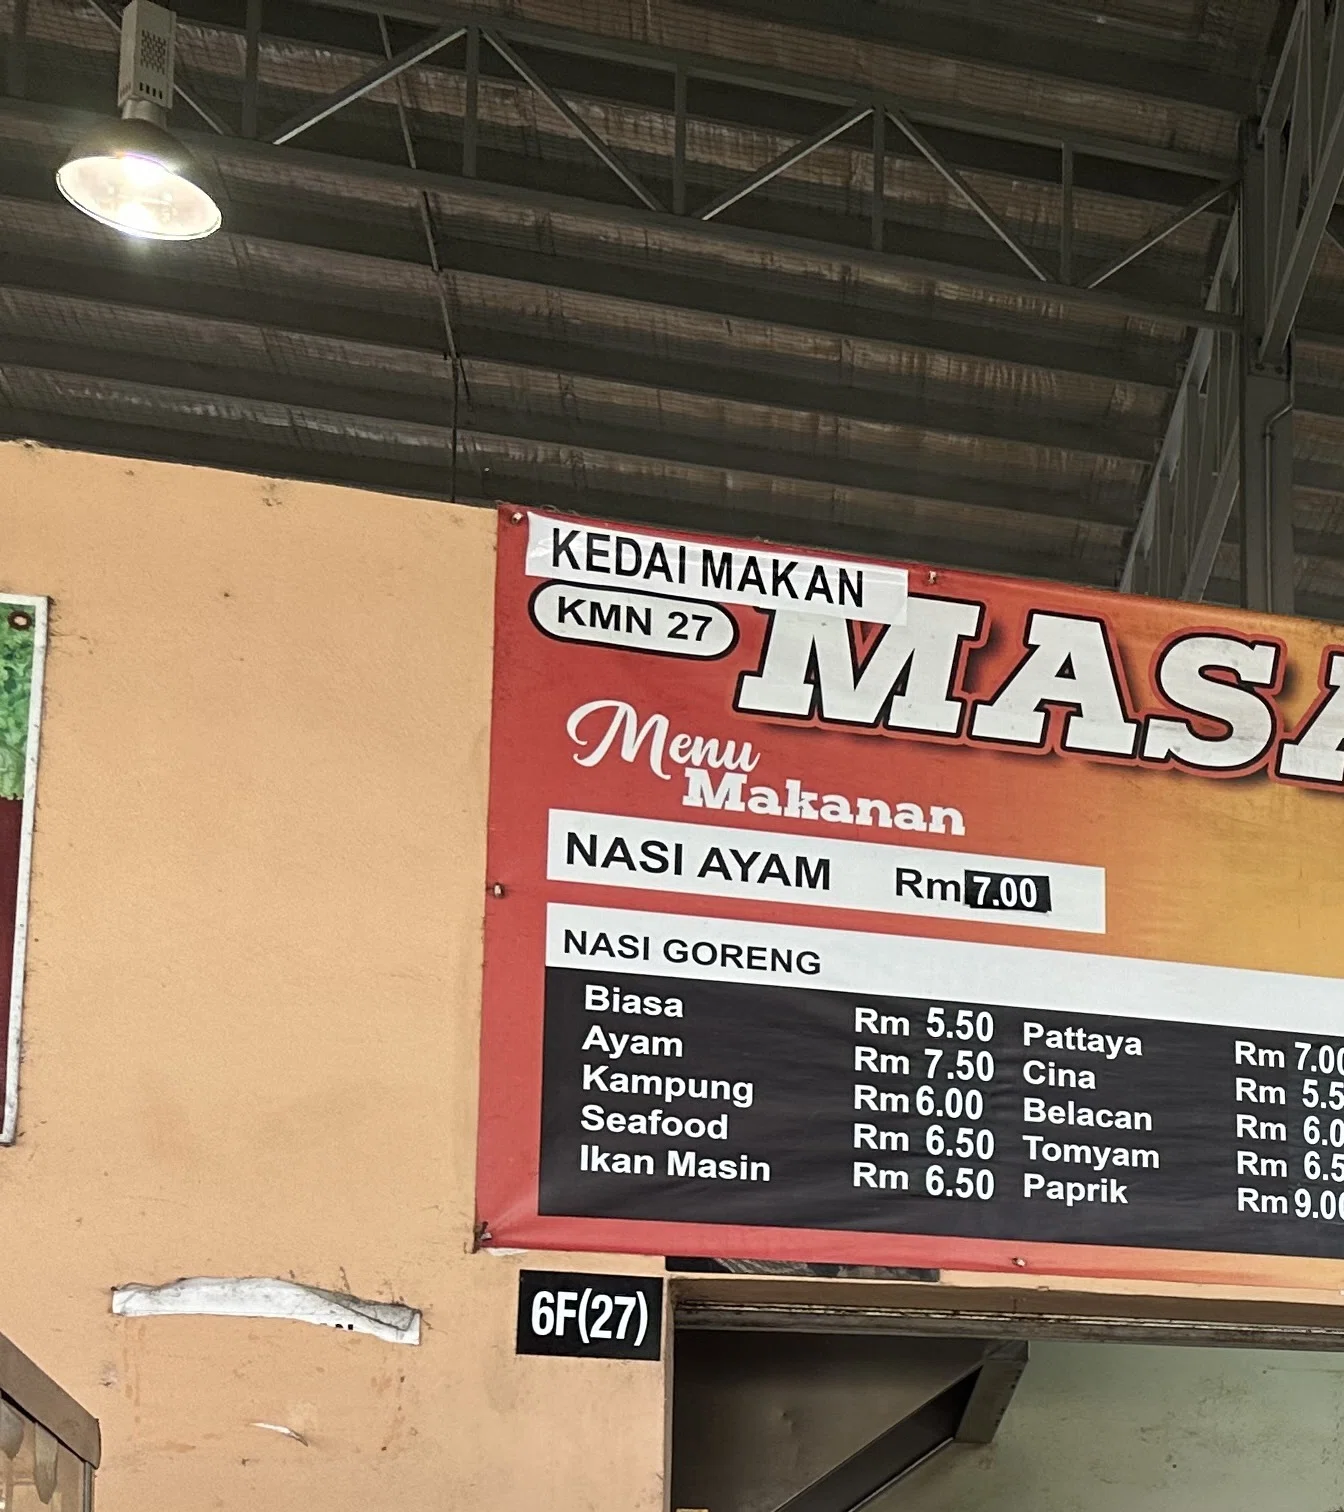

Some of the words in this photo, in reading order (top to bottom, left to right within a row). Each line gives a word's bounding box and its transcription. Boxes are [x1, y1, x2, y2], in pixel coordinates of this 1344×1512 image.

[551, 527, 688, 584] KEDAI
[701, 547, 865, 608] MAKAN
[557, 597, 652, 635] KMN
[667, 611, 712, 641] 27
[566, 699, 760, 779] Menu
[682, 767, 965, 836] Makanan
[566, 832, 682, 876] NASI
[698, 847, 830, 890] AYAM
[564, 930, 649, 960] NASI
[664, 940, 821, 974] GORENG
[585, 985, 683, 1018] Biasa
[854, 1007, 909, 1036] Rm
[926, 1008, 993, 1042] 5.50
[582, 1025, 682, 1059] Ayam
[854, 1047, 909, 1075] Rm
[924, 1049, 994, 1081] 7.50
[1023, 1021, 1142, 1059] Pattaya
[1235, 1041, 1285, 1069] Rm
[582, 1065, 754, 1107] Kampung
[1023, 1060, 1095, 1089] Cina
[1236, 1077, 1285, 1105] Rm
[581, 1105, 727, 1139] Seafood
[853, 1124, 909, 1151] Rm
[926, 1126, 994, 1159] 6.50
[1023, 1097, 1152, 1131] Belacan
[1236, 1114, 1286, 1141] Rm
[580, 1145, 654, 1175] Ikan
[667, 1151, 770, 1181] Masin
[853, 1162, 909, 1190] Rm
[925, 1165, 994, 1200] 6.50
[1022, 1135, 1160, 1170] Tomyam
[1237, 1151, 1287, 1178] Rm
[1024, 1173, 1128, 1206] Paprik
[531, 1287, 649, 1347] 6F(27)
